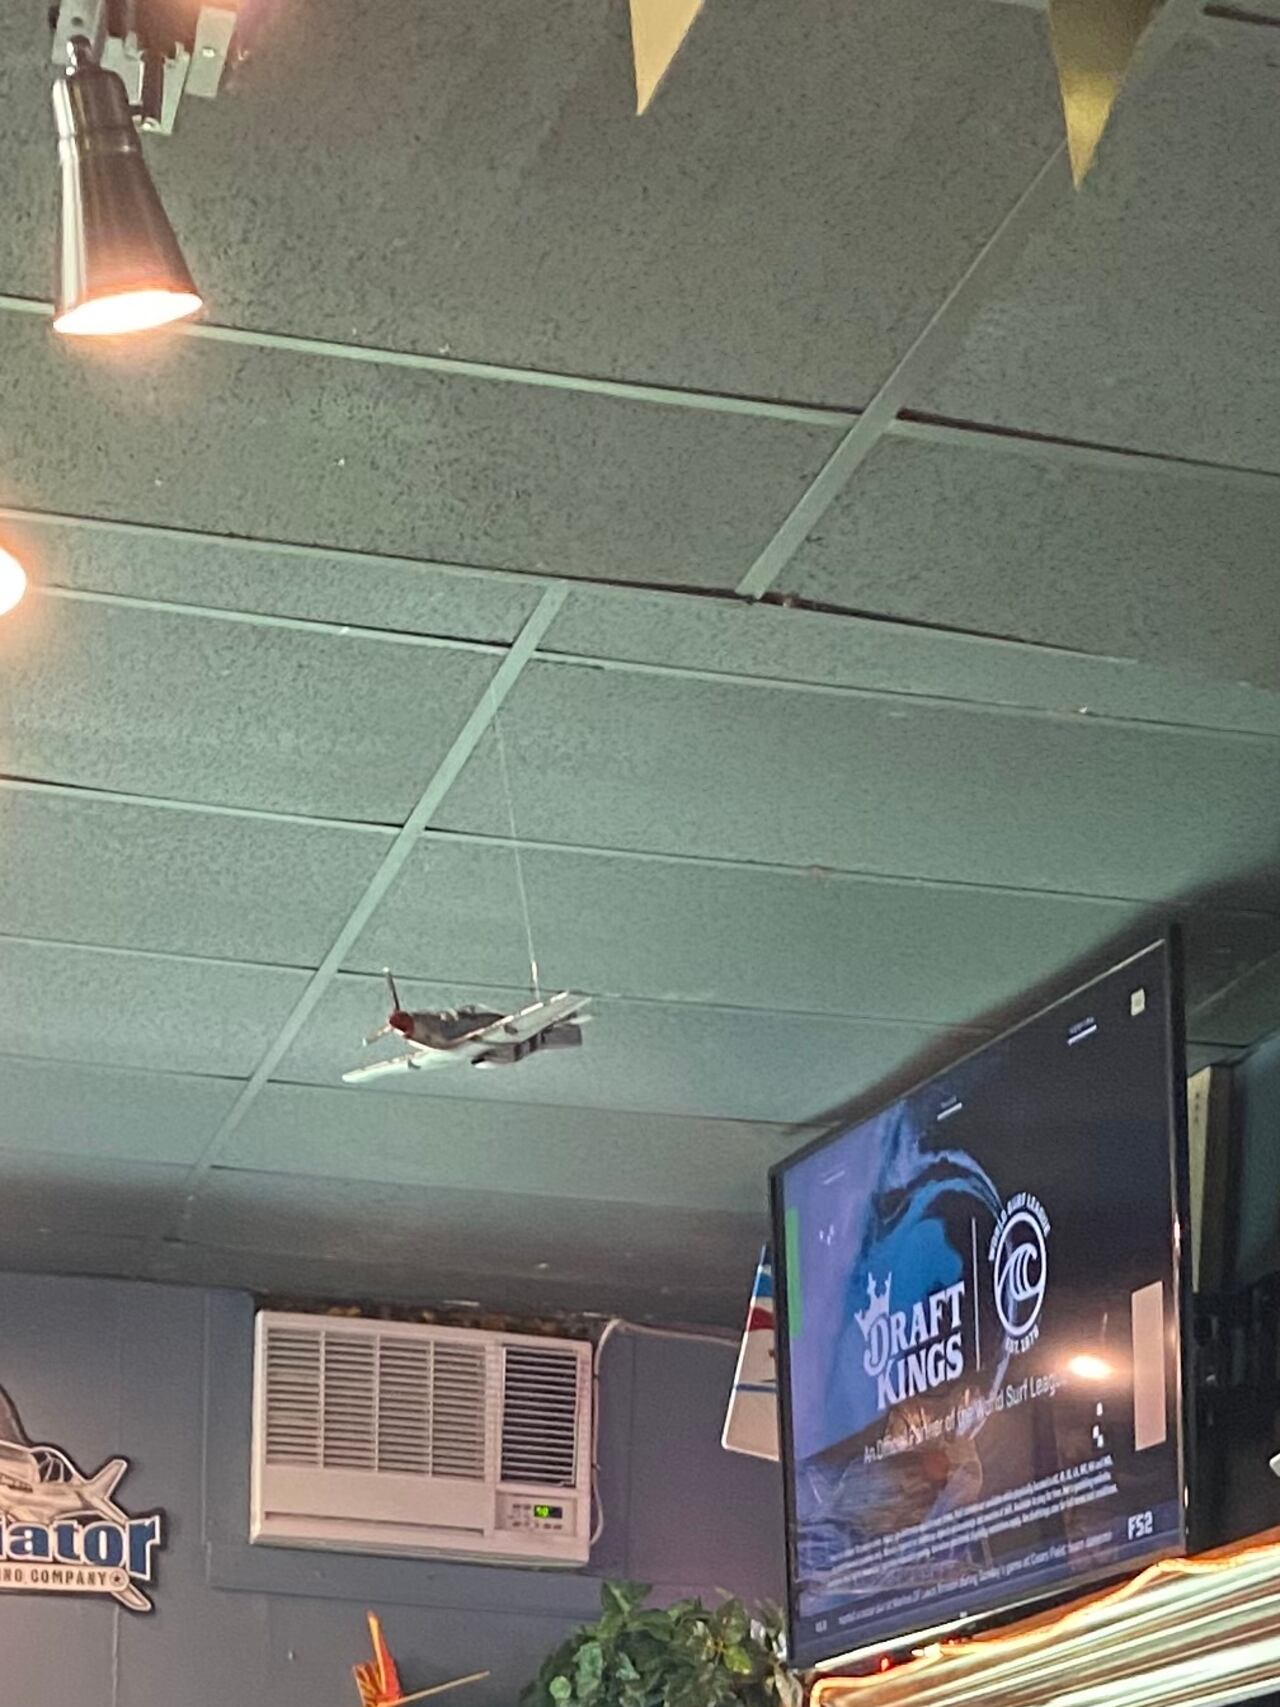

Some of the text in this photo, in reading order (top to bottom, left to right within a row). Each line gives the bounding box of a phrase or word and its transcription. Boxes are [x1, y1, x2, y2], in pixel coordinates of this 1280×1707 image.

[863, 1280, 965, 1377] DRAFT
[876, 1331, 964, 1412] KINGS
[1127, 1510, 1154, 1541] FS2
[31, 1568, 108, 1587] COMPANY
